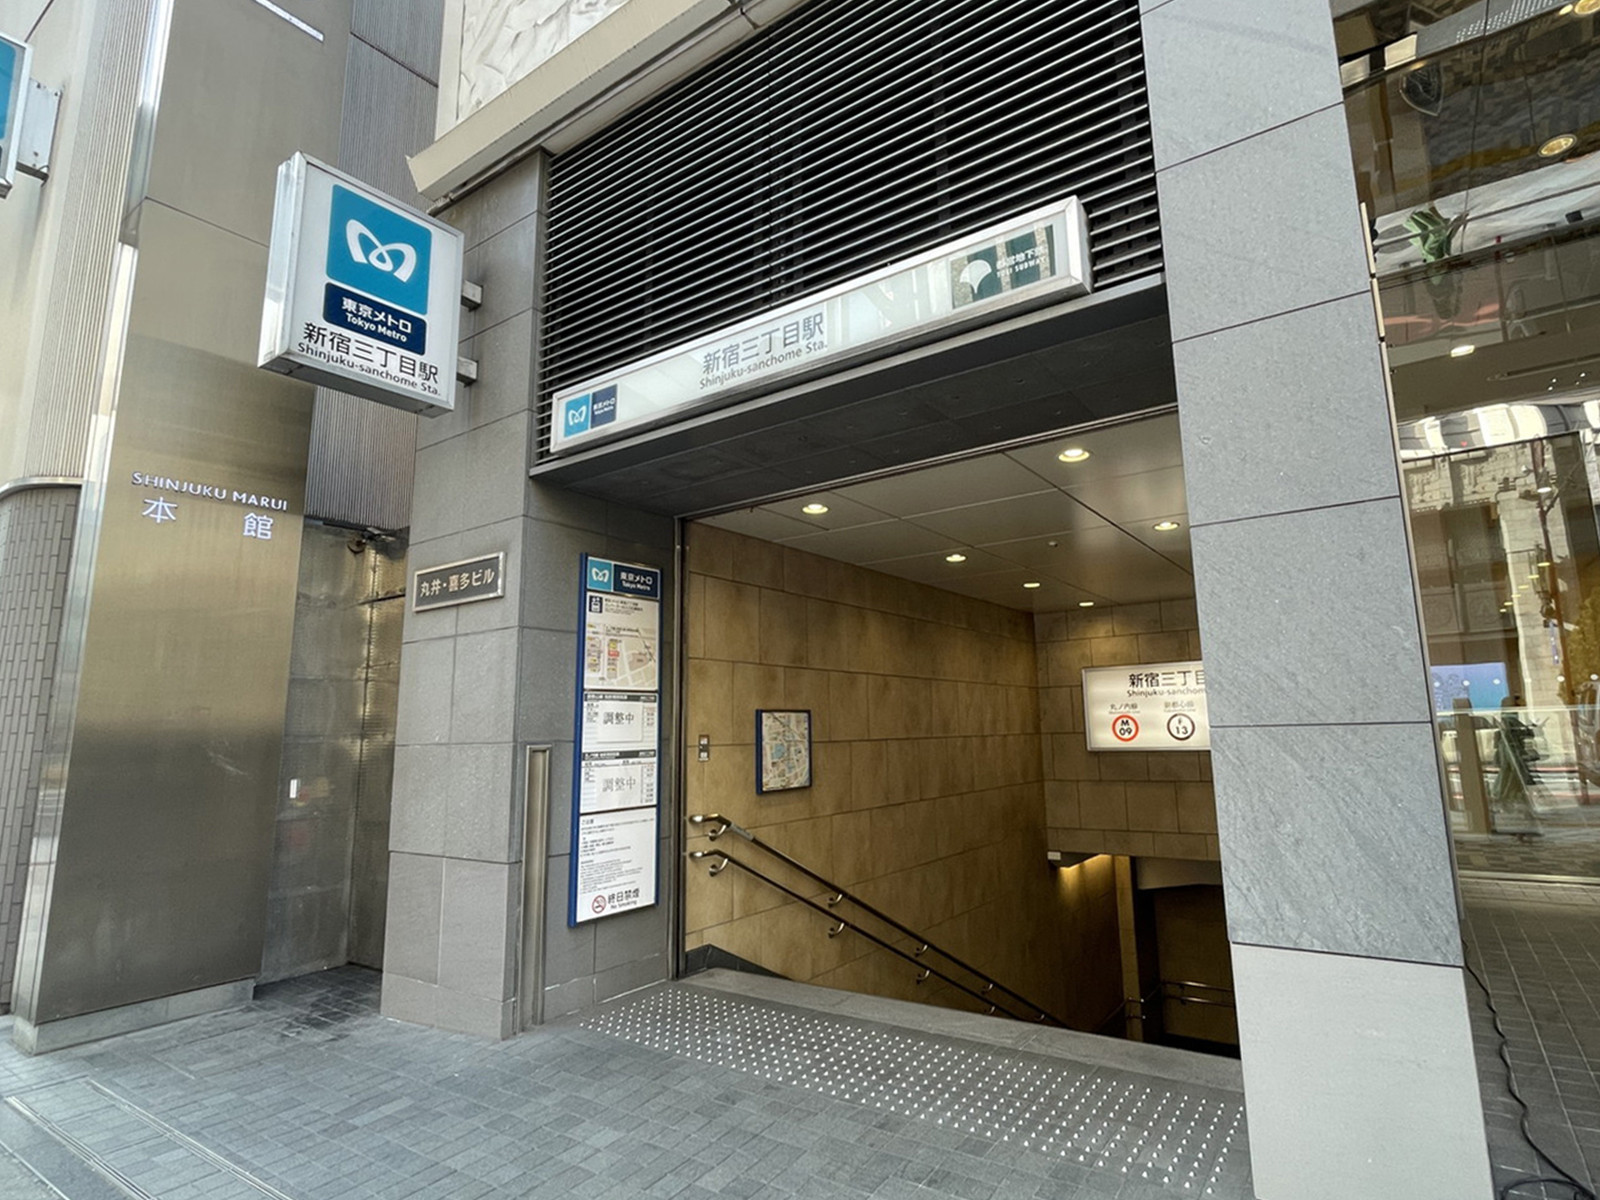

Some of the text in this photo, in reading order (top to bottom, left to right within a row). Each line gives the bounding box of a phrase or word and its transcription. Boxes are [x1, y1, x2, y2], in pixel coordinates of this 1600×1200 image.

[342, 296, 411, 333] 東京メトロ
[345, 311, 407, 343] Tokyo Metro
[303, 322, 439, 385] 新宿三丁目駅
[702, 312, 824, 375] 新宿三丁目駅
[298, 342, 441, 396] Shinjuku-sanchome Sta.
[699, 340, 828, 390] Shinjuku-sanchome Sta.
[132, 472, 288, 511] SHINJUKU MARUI
[1119, 727, 1132, 736] 09
[1175, 725, 1189, 735] 13
